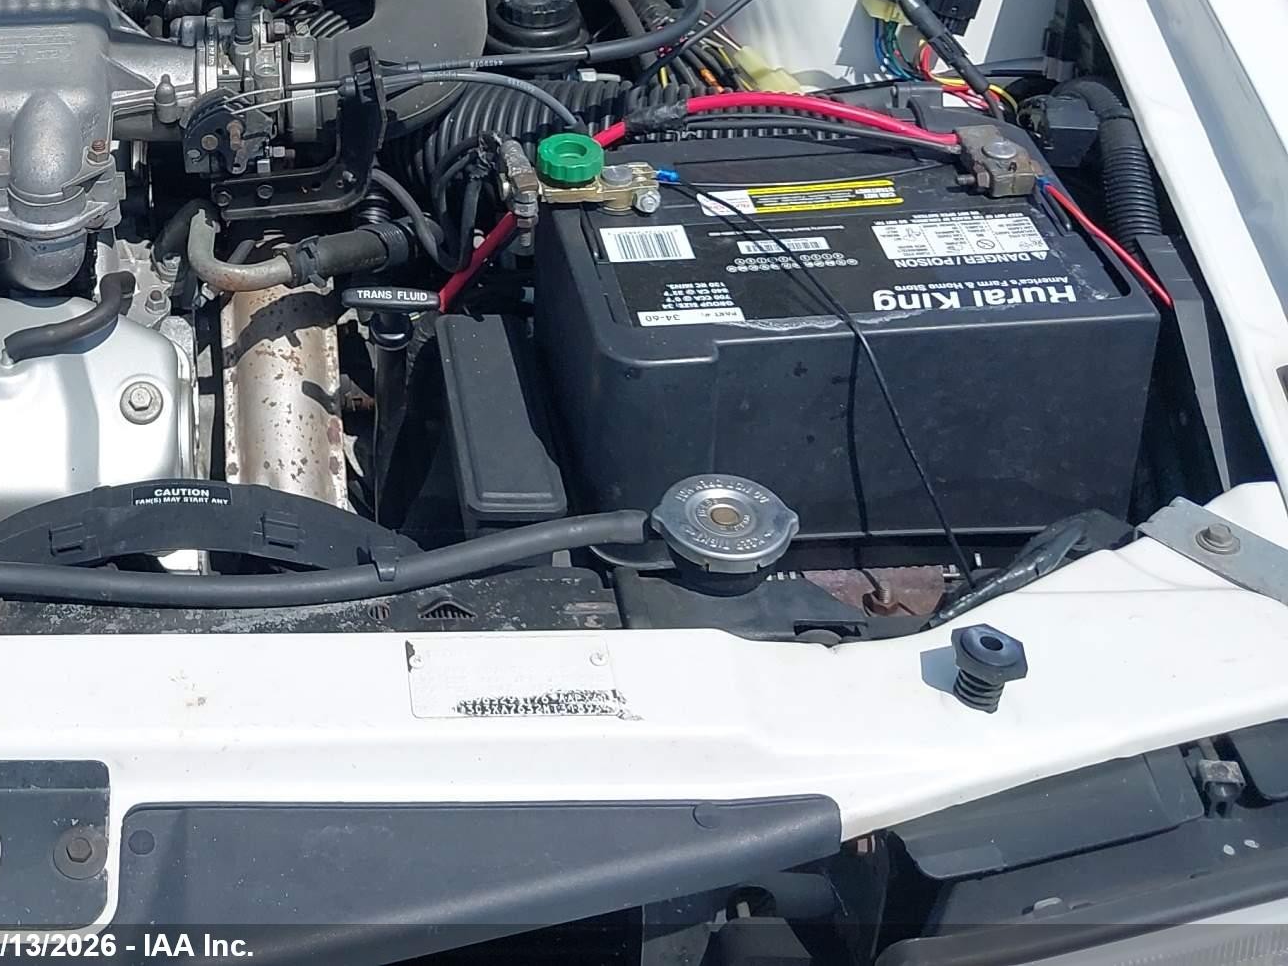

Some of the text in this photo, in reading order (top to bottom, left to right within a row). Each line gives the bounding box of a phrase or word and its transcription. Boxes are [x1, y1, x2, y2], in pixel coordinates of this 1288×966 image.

[895, 257, 954, 268] POISON
[966, 252, 1031, 265] DANGER
[928, 281, 964, 289] Home
[976, 279, 1011, 287] Farm
[1012, 276, 1069, 285] America's
[357, 290, 428, 301] TRANS FLUID
[872, 285, 1077, 311] Rural King
[645, 314, 681, 323] 34-60
[154, 488, 210, 497] CAUTION
[135, 497, 162, 506] FAN(S)
